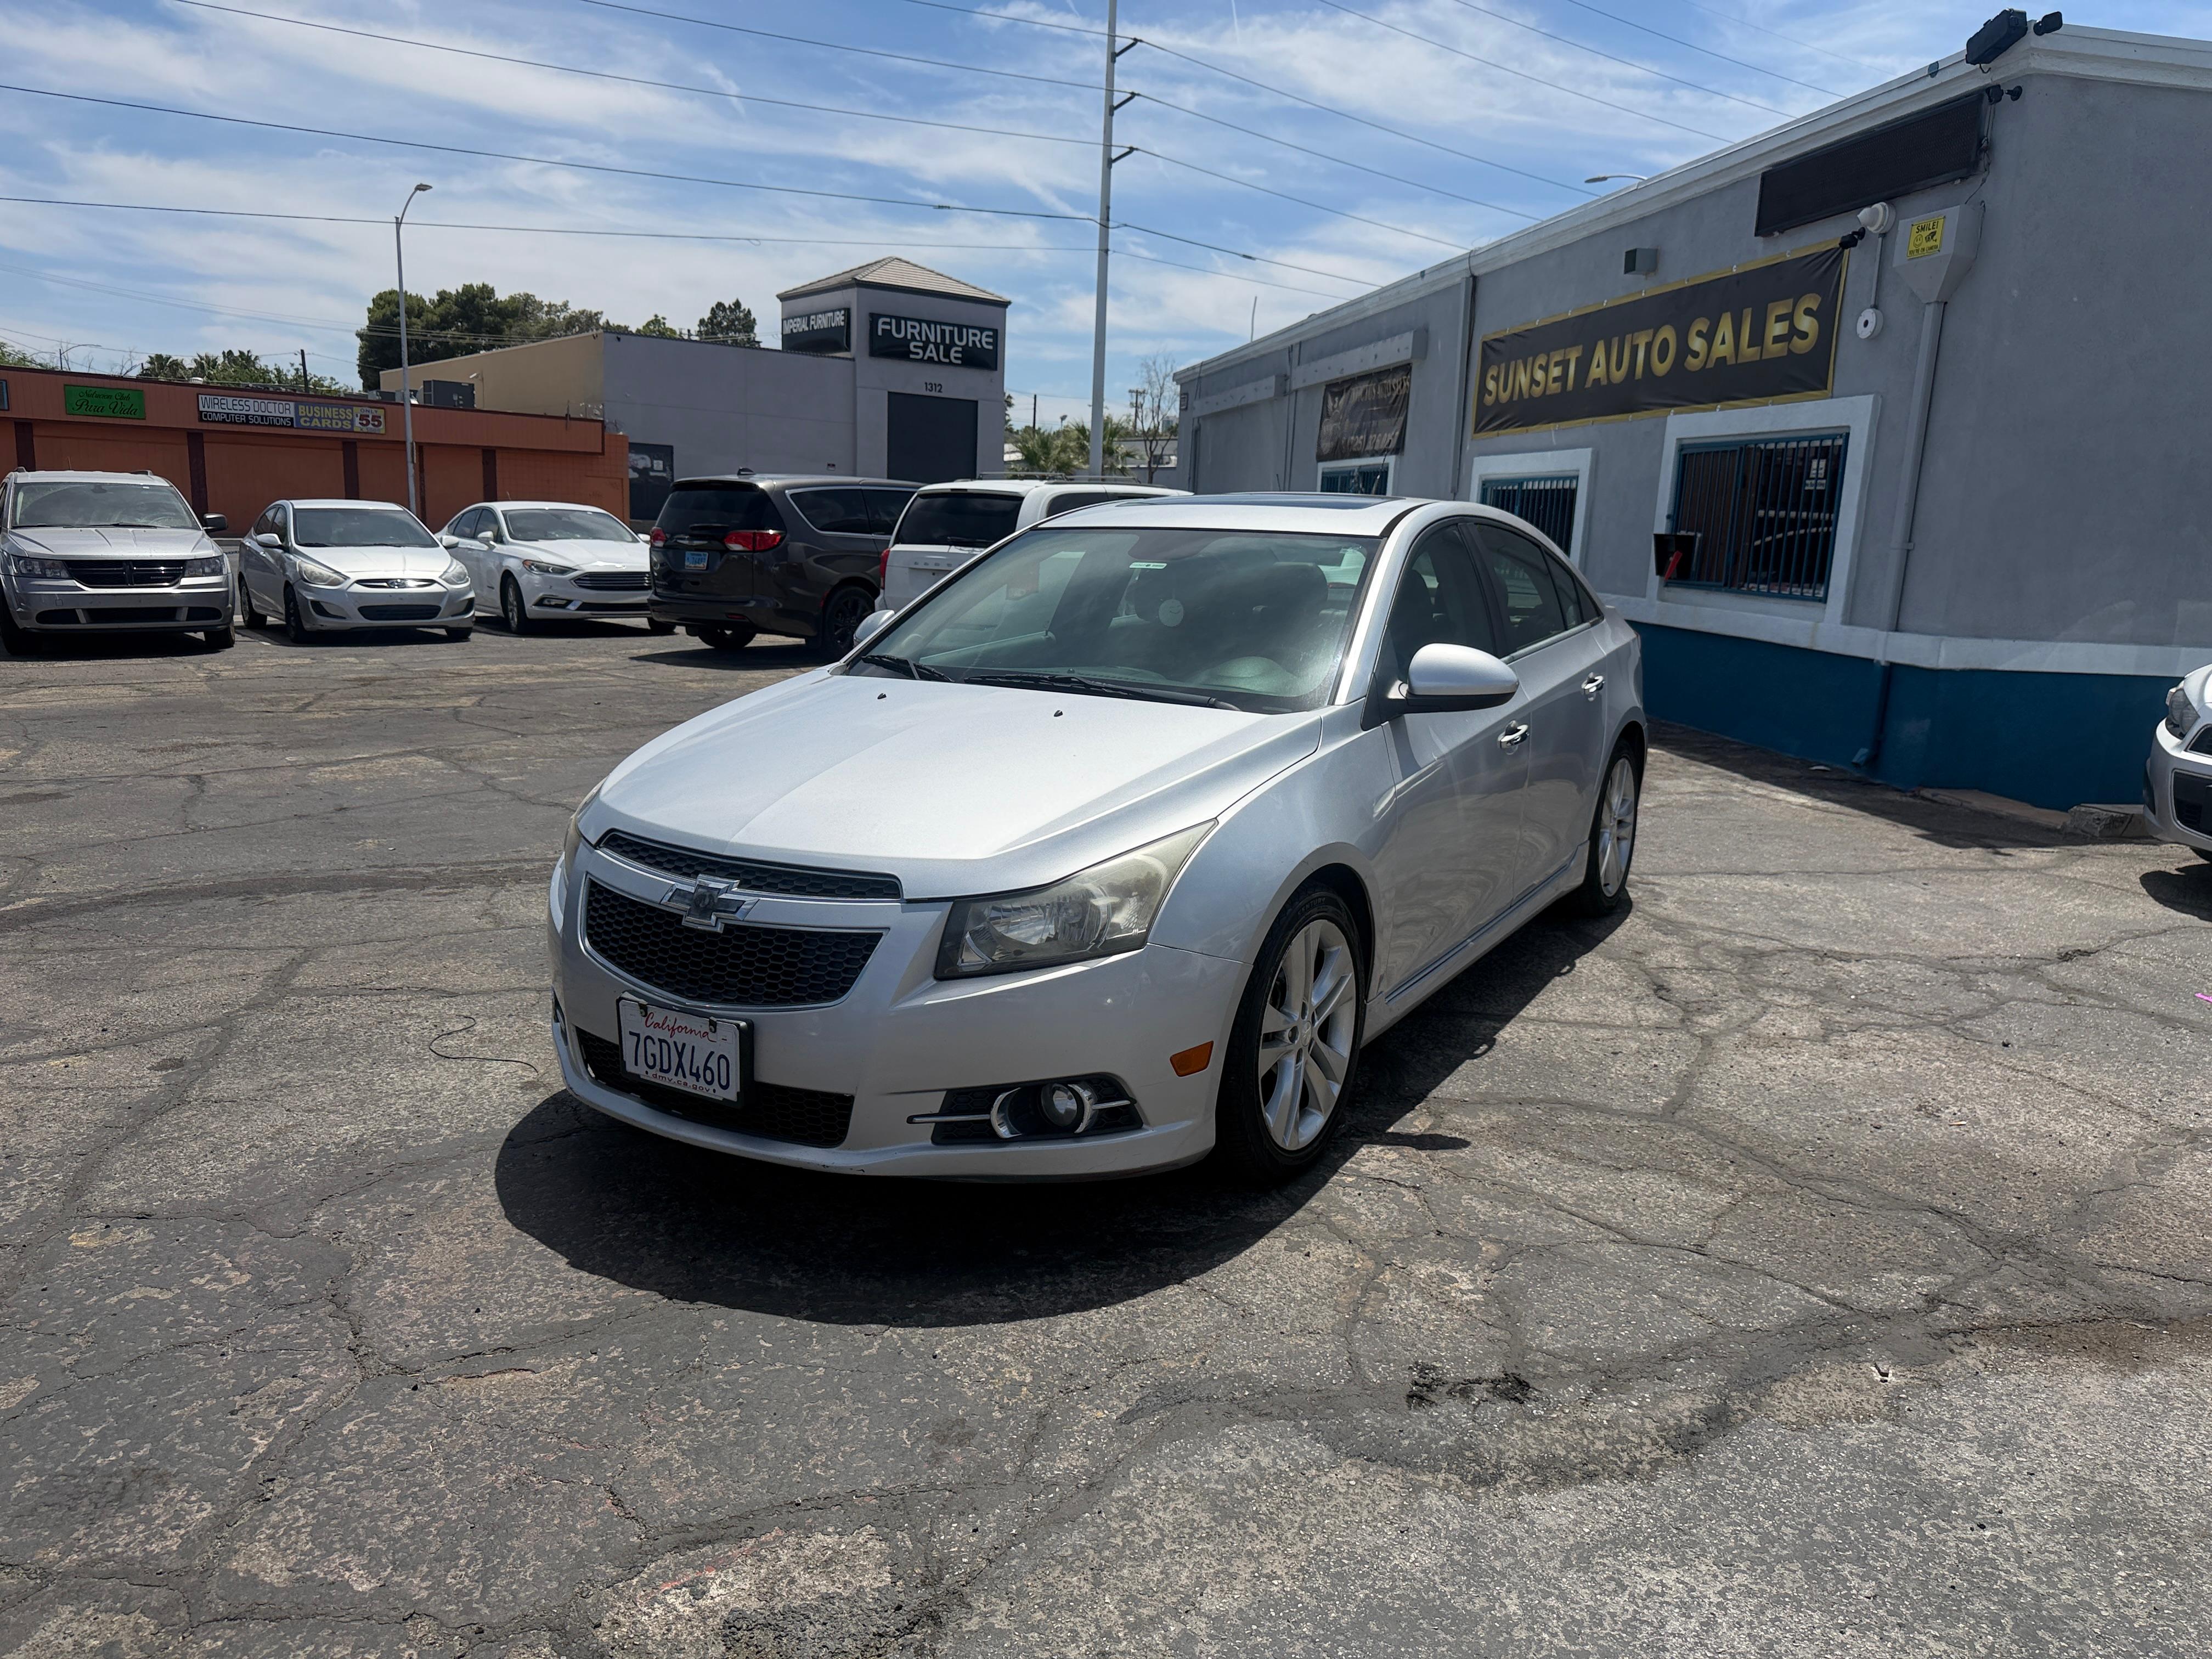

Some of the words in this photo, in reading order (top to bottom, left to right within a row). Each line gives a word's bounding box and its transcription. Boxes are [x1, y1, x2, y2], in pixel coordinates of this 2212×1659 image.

[1916, 221, 1939, 234] SMILE!
[783, 316, 809, 335] IMPERIAL
[810, 310, 845, 330] FURNITURE
[878, 317, 994, 350] FURNITURE
[909, 341, 963, 364] SALE
[1483, 345, 1583, 407] SUNSET
[1584, 324, 1677, 389] AUTO
[1684, 292, 1822, 372] SALES
[114, 392, 131, 401] Club
[924, 382, 943, 393] 1312
[72, 398, 105, 413] Pura
[109, 400, 138, 415] Vida
[200, 396, 251, 412] WIRELESS
[253, 400, 291, 415] DOCTOR
[298, 405, 353, 420] BUSINESS
[202, 411, 246, 424] COMPUTER
[249, 415, 291, 426] SOLUTIONS
[300, 417, 352, 430] CARDS
[645, 1012, 717, 1042] California
[629, 1031, 730, 1091] 7GDX460
[652, 1073, 710, 1092] dmv.ca.gov
